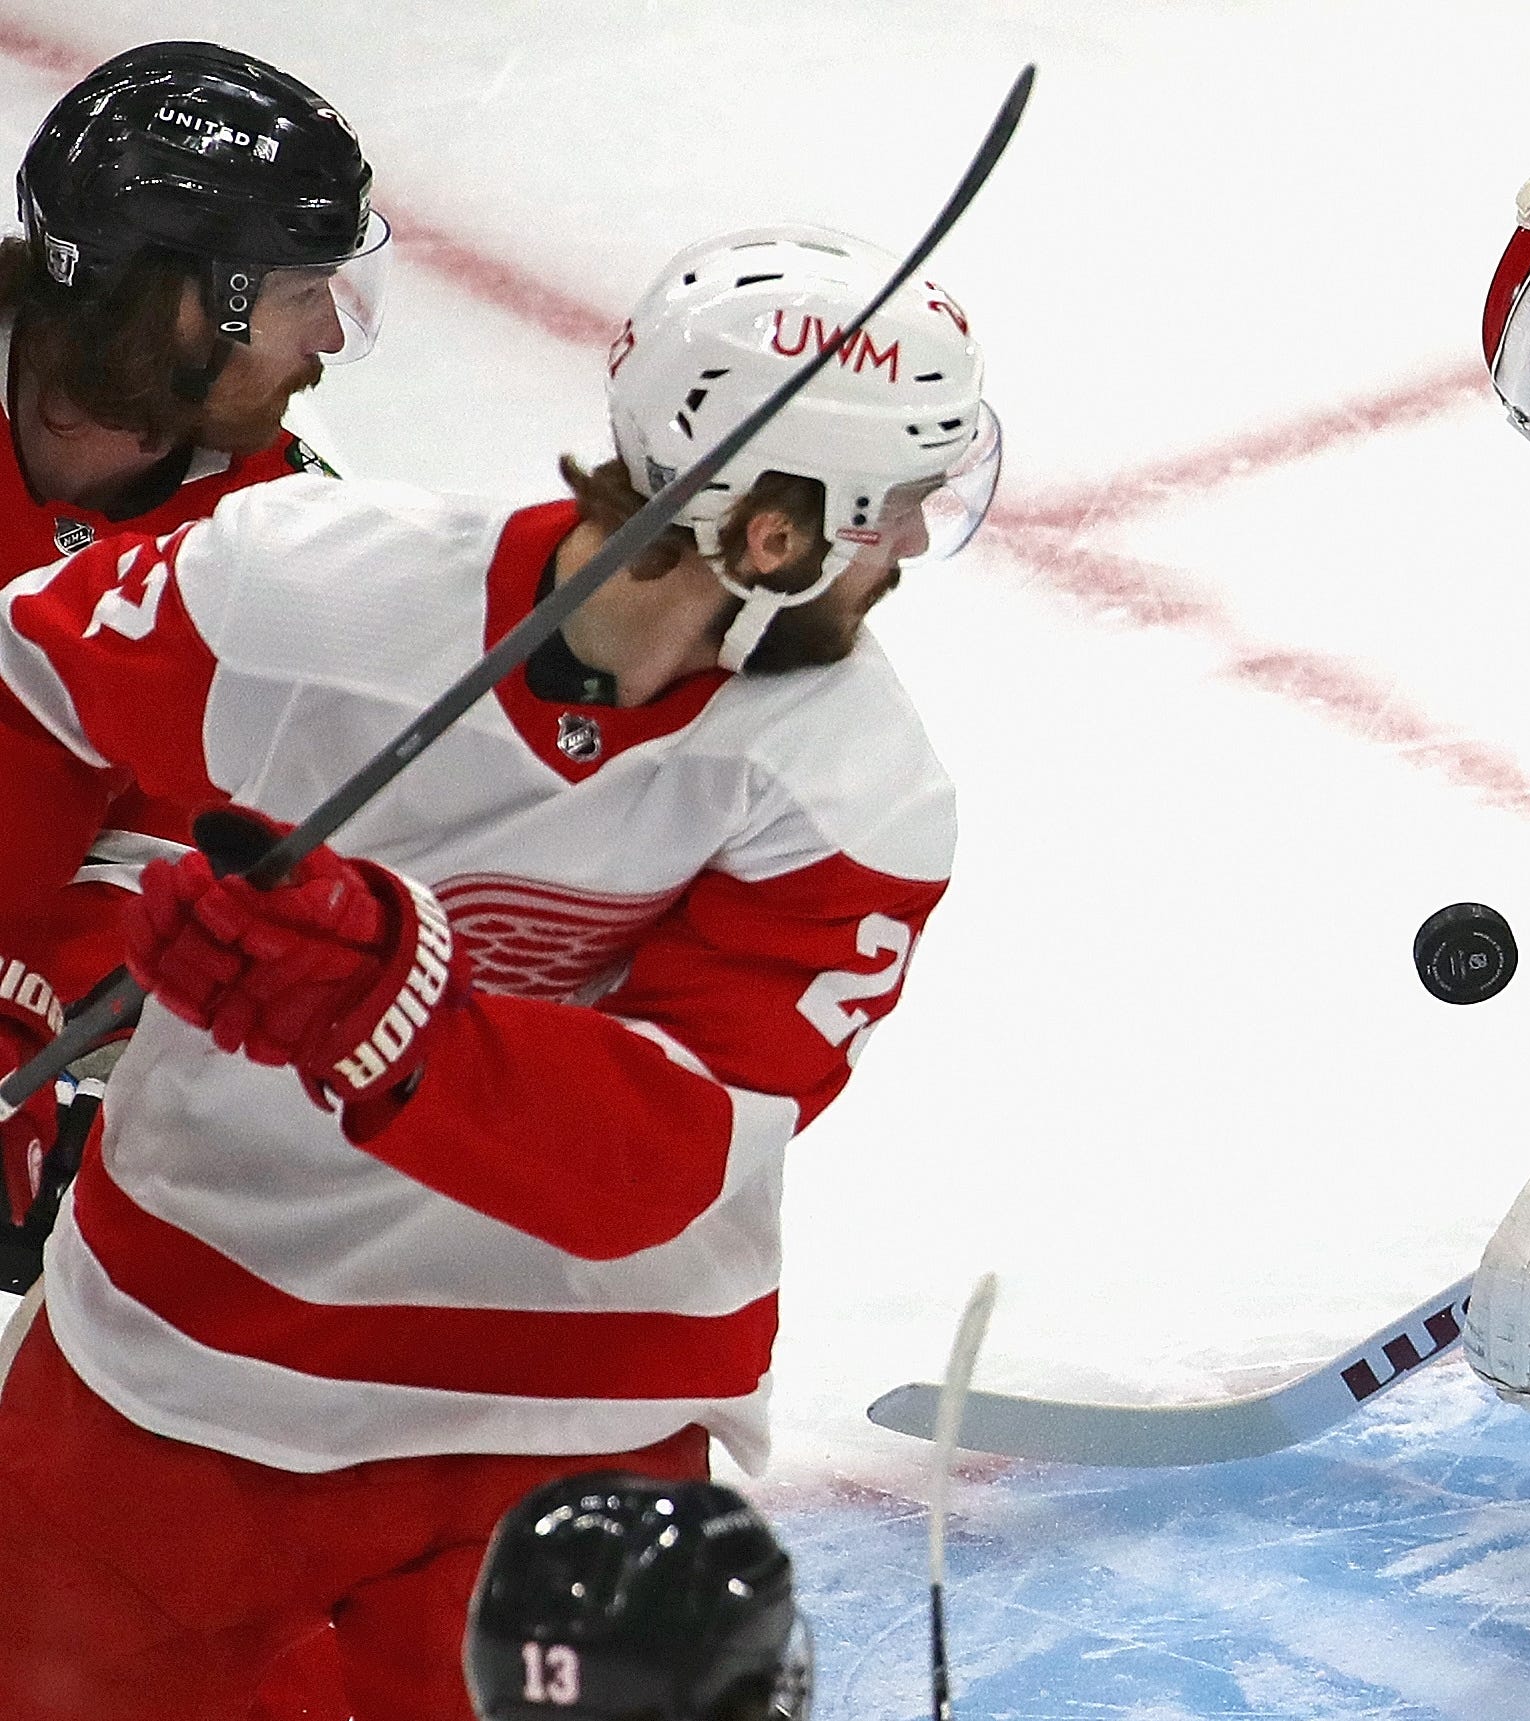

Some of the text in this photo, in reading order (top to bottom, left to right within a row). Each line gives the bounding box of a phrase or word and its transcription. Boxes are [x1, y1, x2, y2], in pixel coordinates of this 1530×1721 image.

[158, 106, 251, 147] UNITED
[771, 309, 899, 384] UWM
[62, 530, 88, 548] NHL
[795, 912, 921, 1069] 2
[520, 1641, 580, 1705] 13
